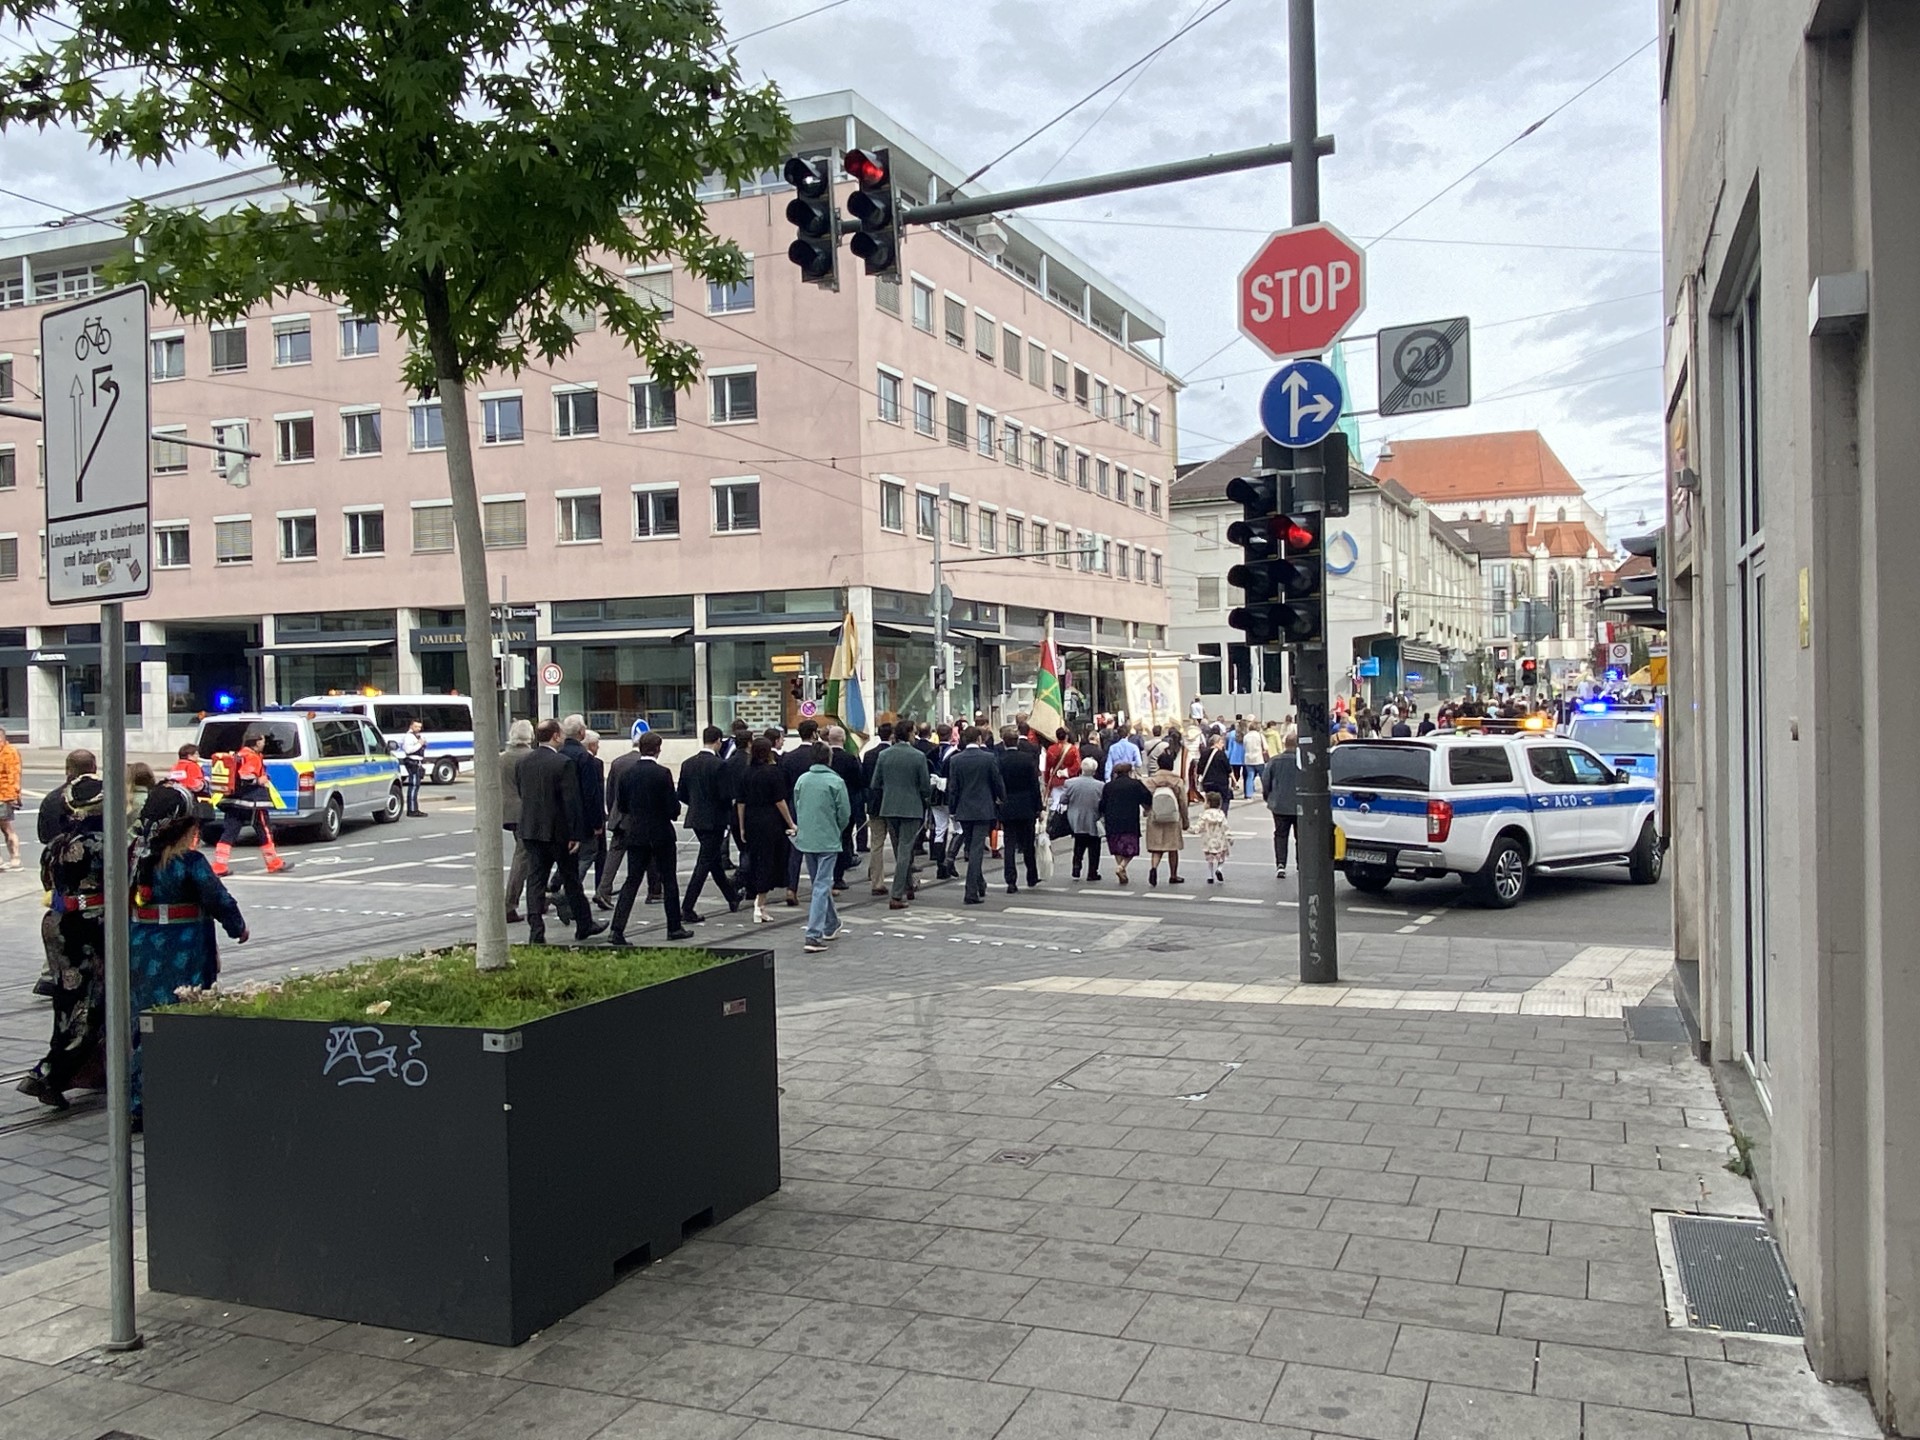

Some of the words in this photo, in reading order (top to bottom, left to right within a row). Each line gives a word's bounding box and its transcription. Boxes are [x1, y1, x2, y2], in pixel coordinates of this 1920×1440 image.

[1249, 260, 1352, 324] STOP
[1407, 343, 1442, 374] 20
[1401, 389, 1447, 409] ZONE
[50, 529, 97, 548] Linksabbieger
[100, 528, 108, 541] so
[110, 522, 145, 539] einordnen
[546, 669, 558, 680] 30
[1555, 794, 1578, 808] ACO
